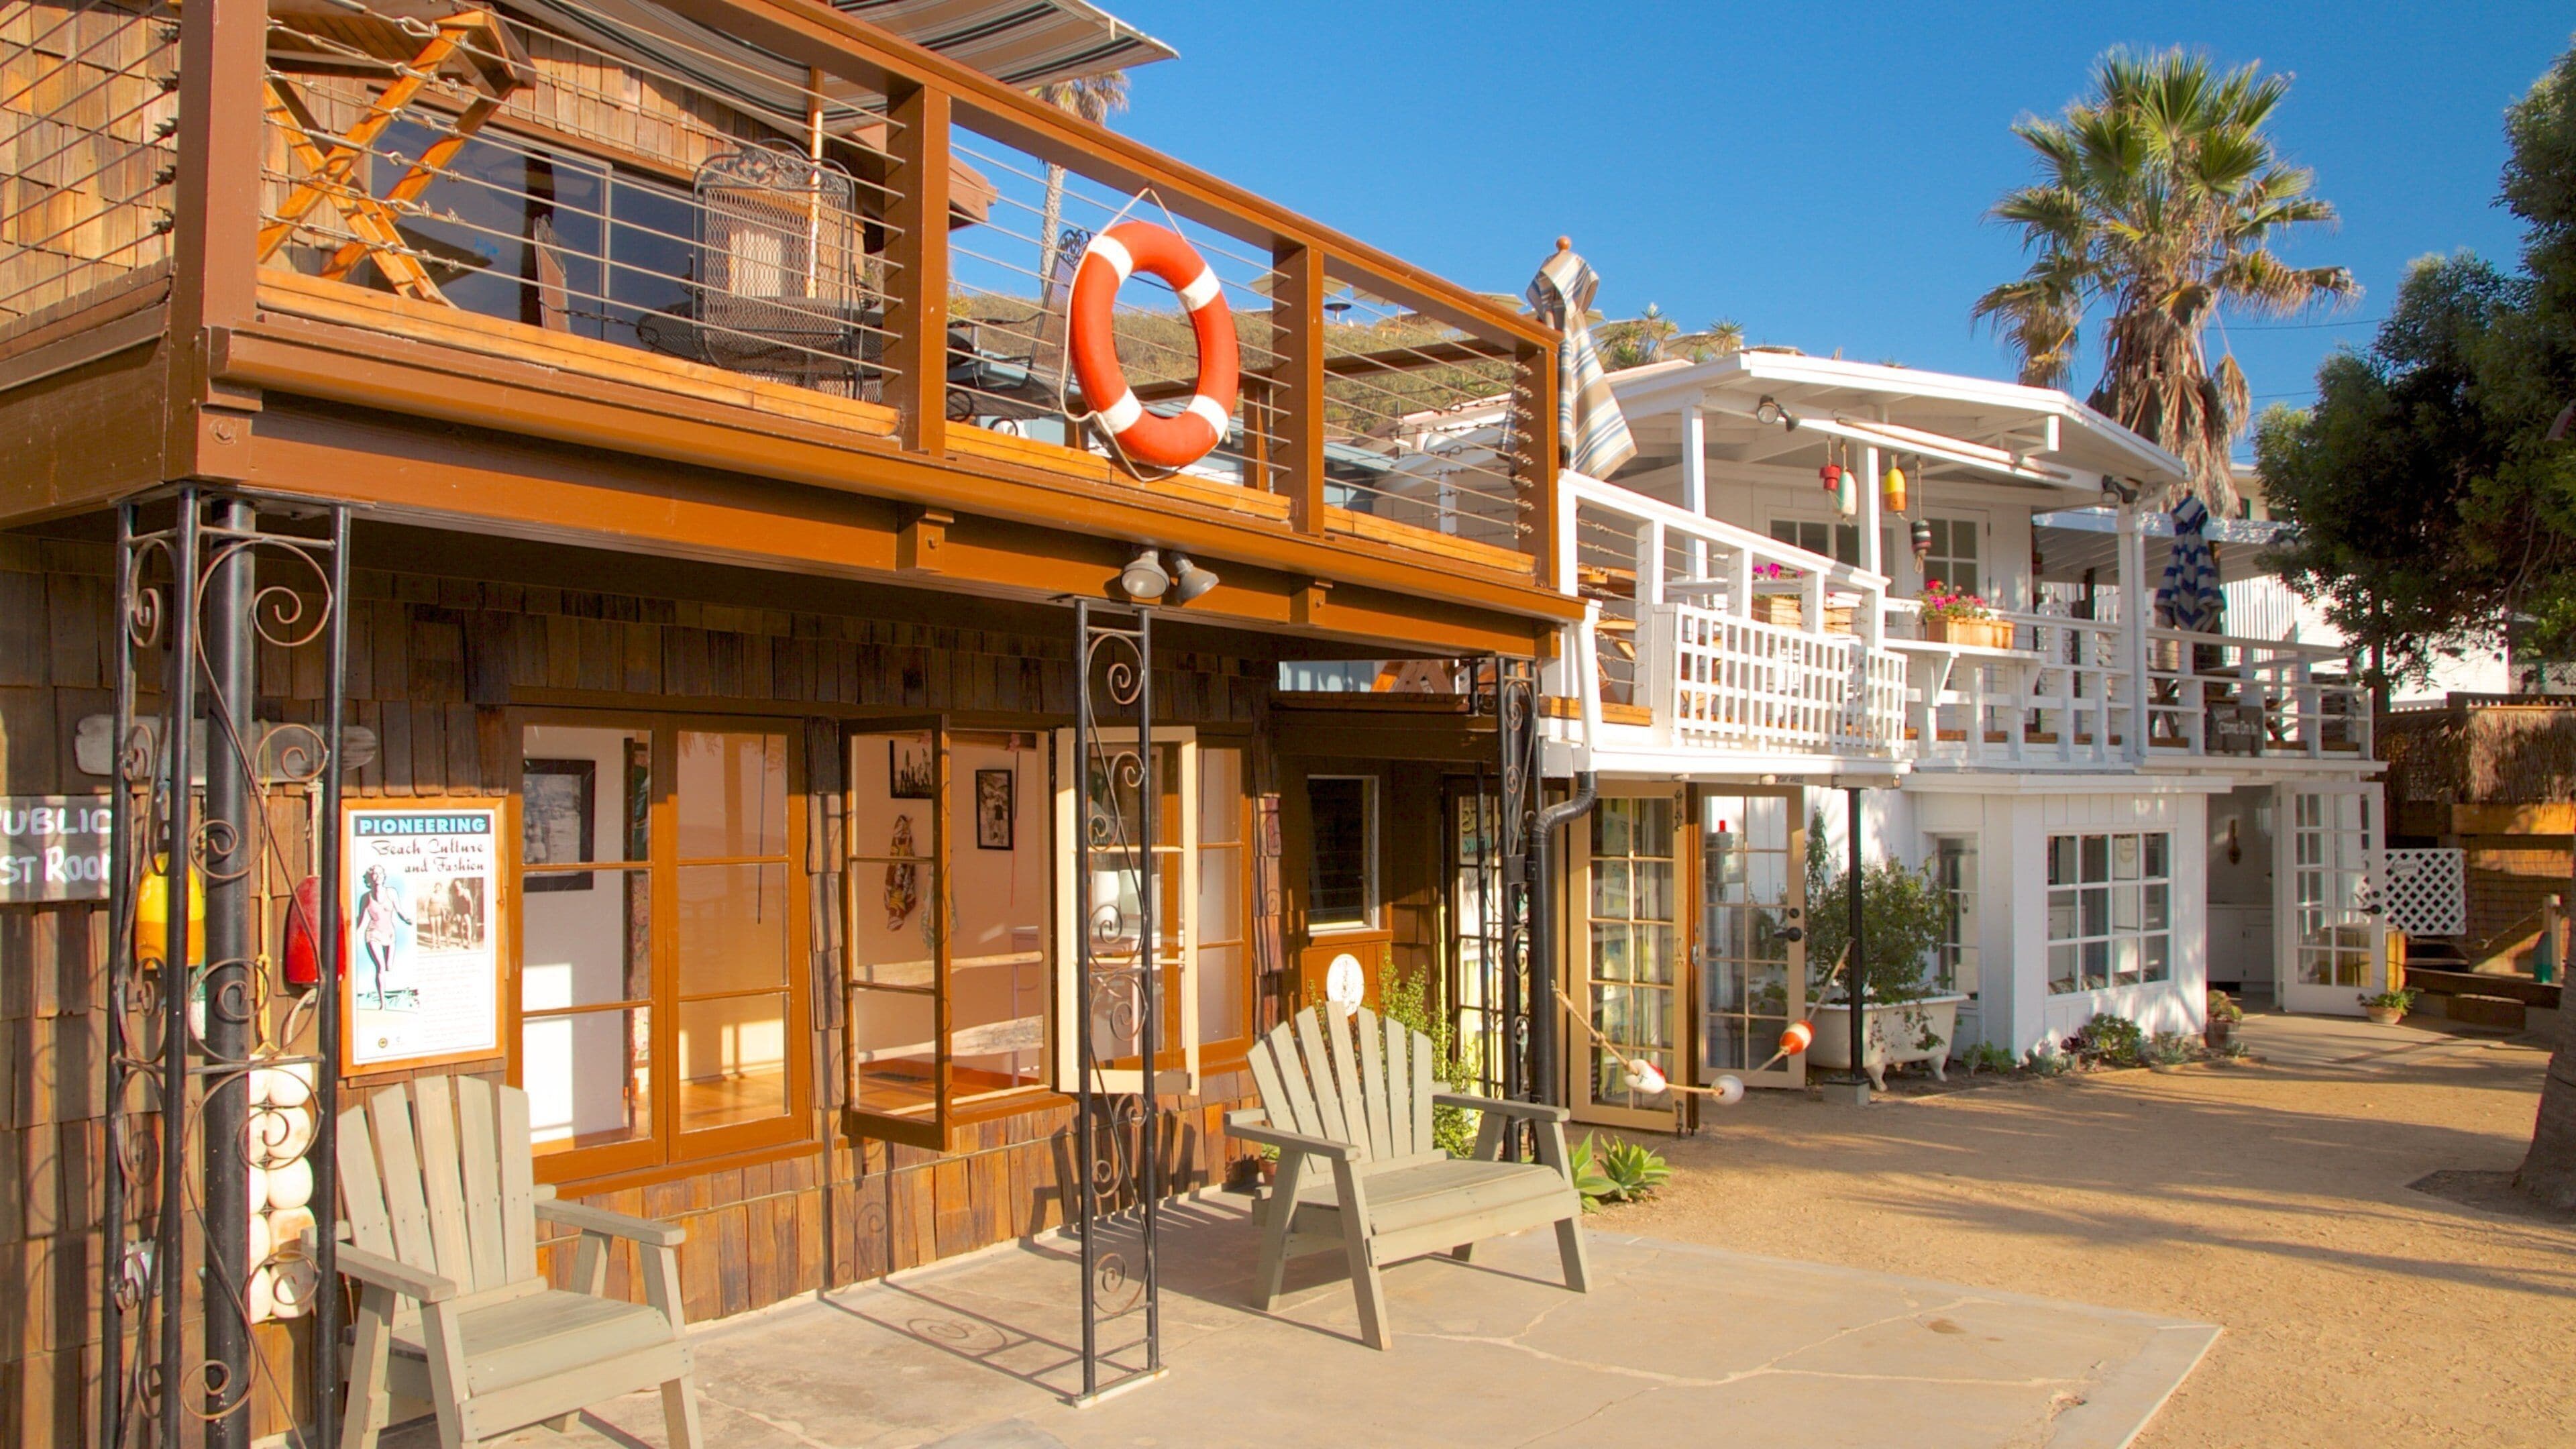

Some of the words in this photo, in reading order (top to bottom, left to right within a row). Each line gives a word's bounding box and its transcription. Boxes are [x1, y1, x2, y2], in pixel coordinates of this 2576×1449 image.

[0, 807, 112, 836] UBLIC
[359, 817, 487, 835] PIONEERING
[371, 839, 421, 855] Beach
[429, 838, 484, 854] Culture
[405, 857, 429, 873] and
[433, 857, 484, 873] Fashion
